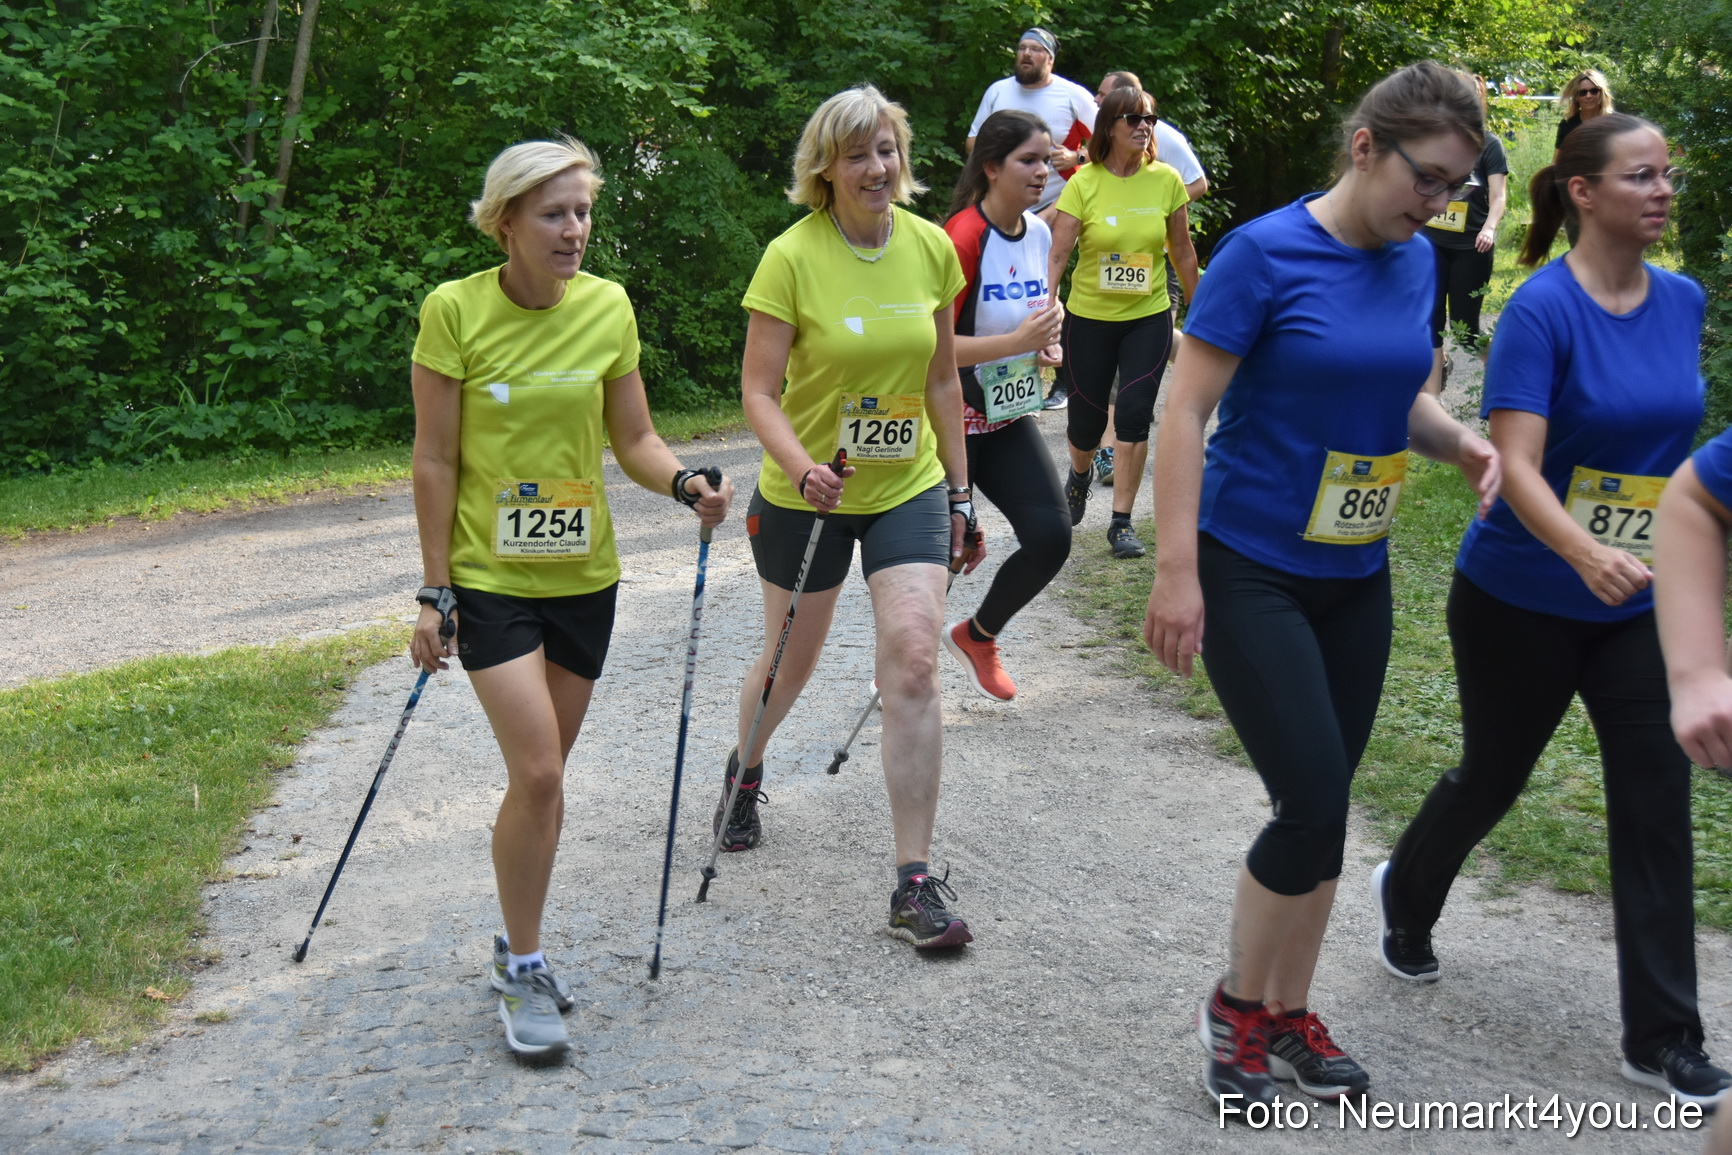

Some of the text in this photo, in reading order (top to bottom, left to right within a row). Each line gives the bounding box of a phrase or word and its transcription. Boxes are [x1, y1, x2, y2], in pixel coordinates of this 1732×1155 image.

[1104, 266, 1145, 282] 1296
[992, 376, 1035, 406] 2062
[848, 419, 913, 445] 1266
[856, 446, 873, 454] Nagl
[1338, 486, 1391, 520] 868
[507, 508, 585, 538] 1254
[1588, 504, 1653, 540] 872
[503, 539, 587, 548] Kurzendorfer Claudia
